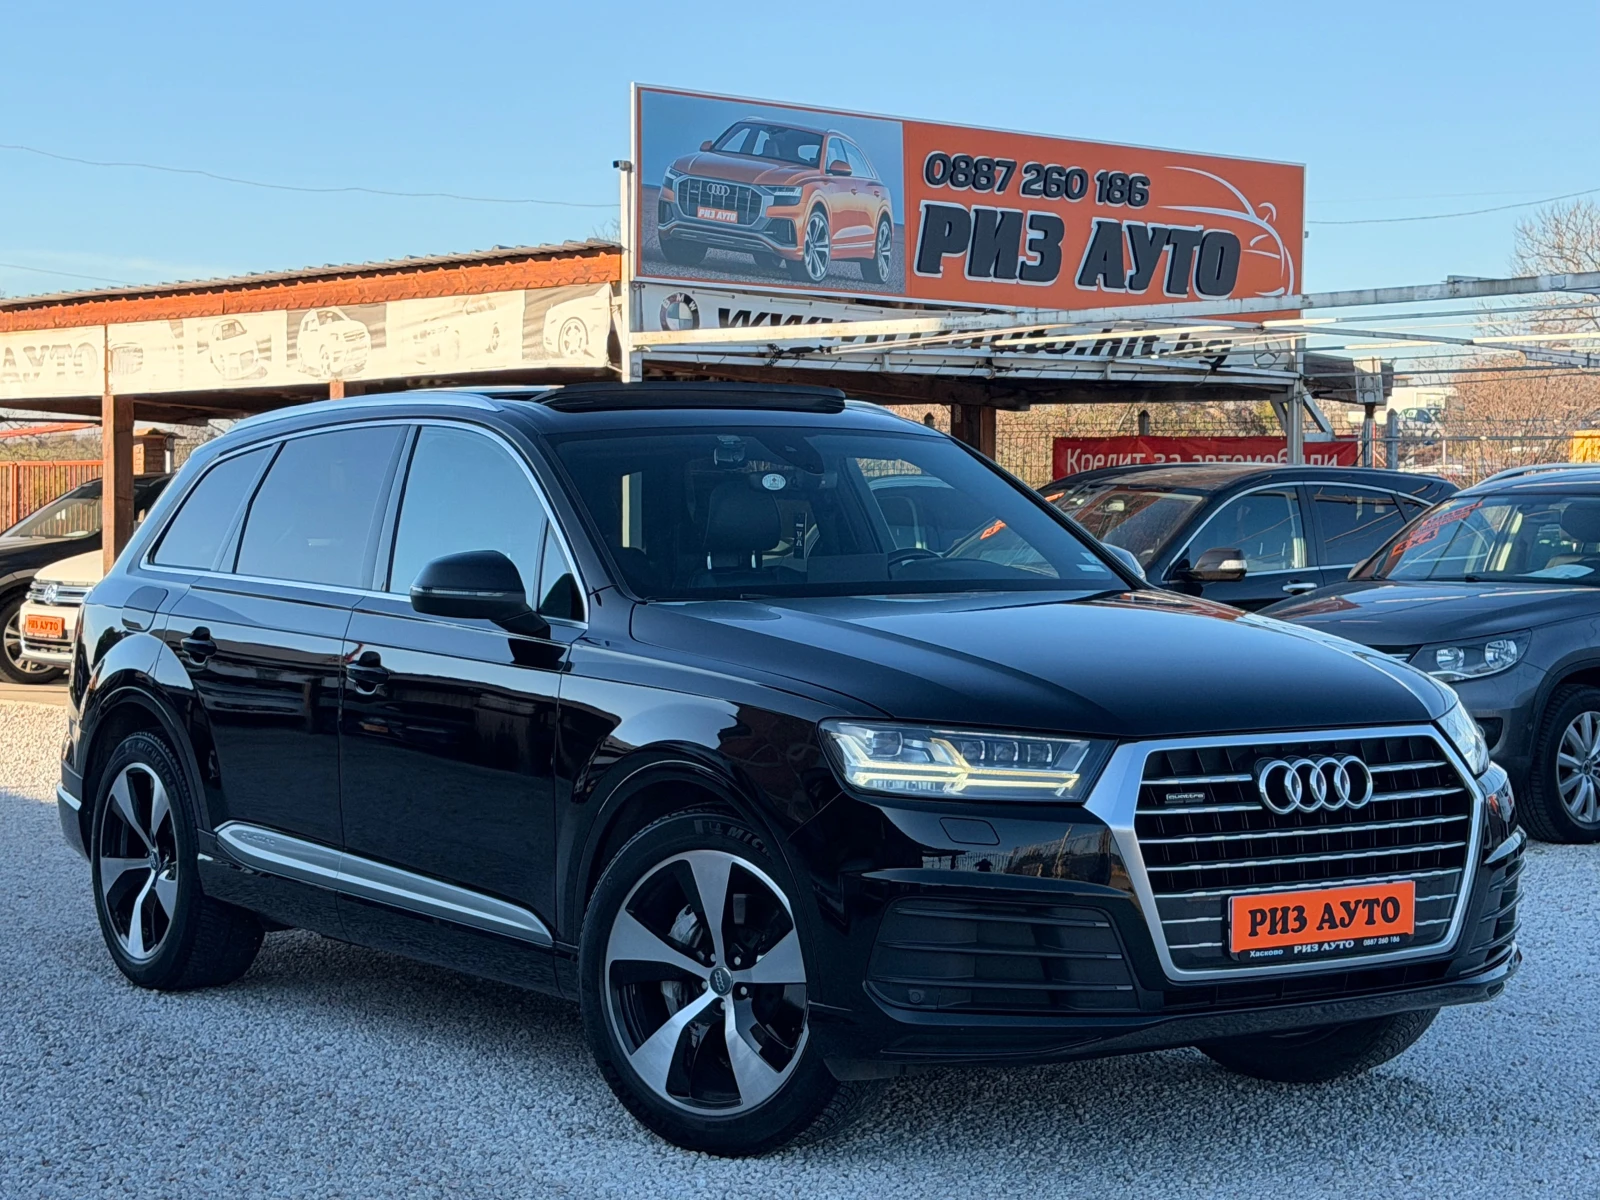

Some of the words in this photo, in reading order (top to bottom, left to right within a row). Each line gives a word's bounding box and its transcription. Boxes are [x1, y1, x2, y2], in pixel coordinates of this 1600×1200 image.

[923, 150, 1017, 194] 0887
[1020, 161, 1089, 201] 260
[1095, 169, 1151, 208] 186
[698, 209, 716, 219] РИЗ
[716, 211, 737, 222] АУТО
[914, 200, 1065, 287] РИЗ
[1075, 217, 1242, 300] АУТО
[1167, 793, 1205, 801] quattro
[1248, 905, 1308, 937] РИЗ
[1316, 896, 1401, 931] АУТО
[1249, 948, 1285, 958] Хасково
[1293, 944, 1319, 955] РИЗ
[1320, 940, 1355, 952] АУТО
[1362, 938, 1377, 947] 0887
[1377, 936, 1389, 945] 260
